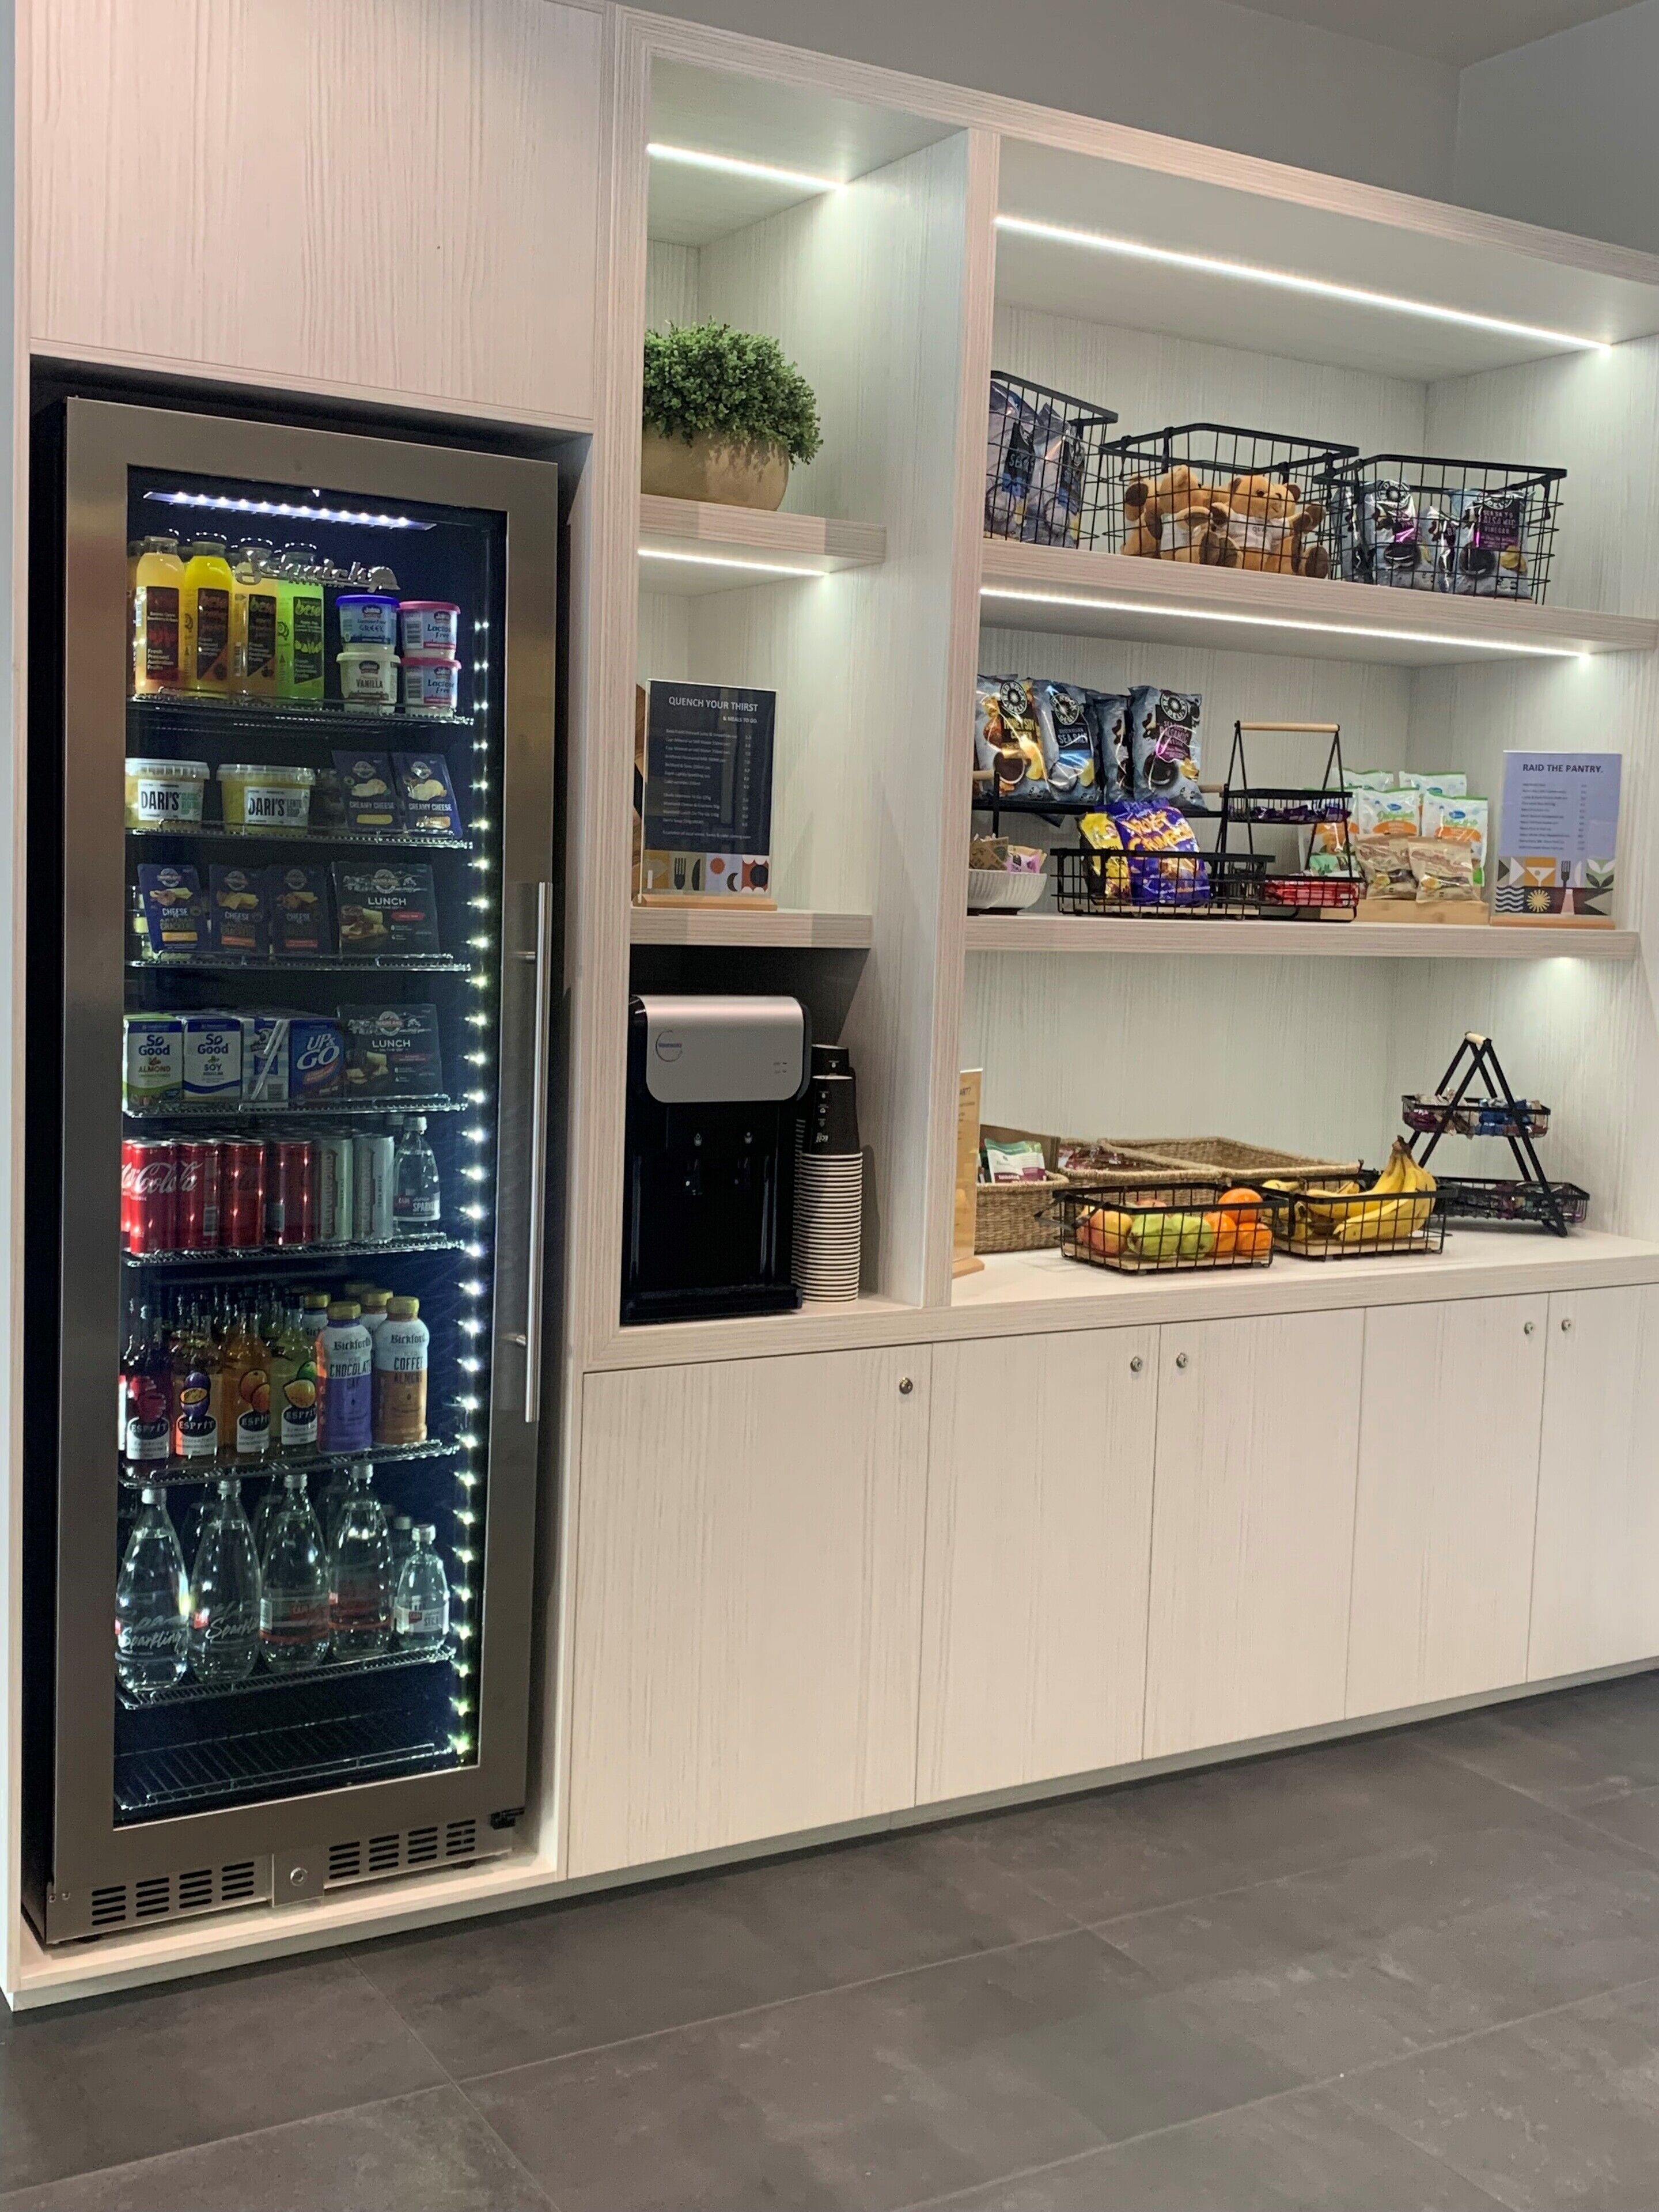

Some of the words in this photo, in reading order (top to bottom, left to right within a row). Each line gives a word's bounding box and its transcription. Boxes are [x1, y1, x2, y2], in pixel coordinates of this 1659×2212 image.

[356, 679, 382, 688] VANILLA
[669, 696, 704, 708] QUENCH
[706, 699, 729, 710] YOUR
[731, 702, 759, 712] THIRST
[1522, 764, 1544, 772] RAID
[1547, 764, 1563, 772] THE
[141, 791, 180, 811] DARI'S
[248, 797, 285, 817] DARI'S
[368, 896, 407, 906] LUNCH
[162, 907, 188, 916] CHEESE
[225, 911, 249, 919] CHEESE
[146, 1035, 164, 1047] So
[206, 1033, 223, 1046] So
[372, 1039, 411, 1048] LUNCH
[138, 1044, 171, 1056] Good
[198, 1043, 229, 1055] Good
[297, 1046, 340, 1070] GO
[329, 1359, 372, 1377] CHOCOLAT
[118, 1627, 182, 1654] Sparkling
